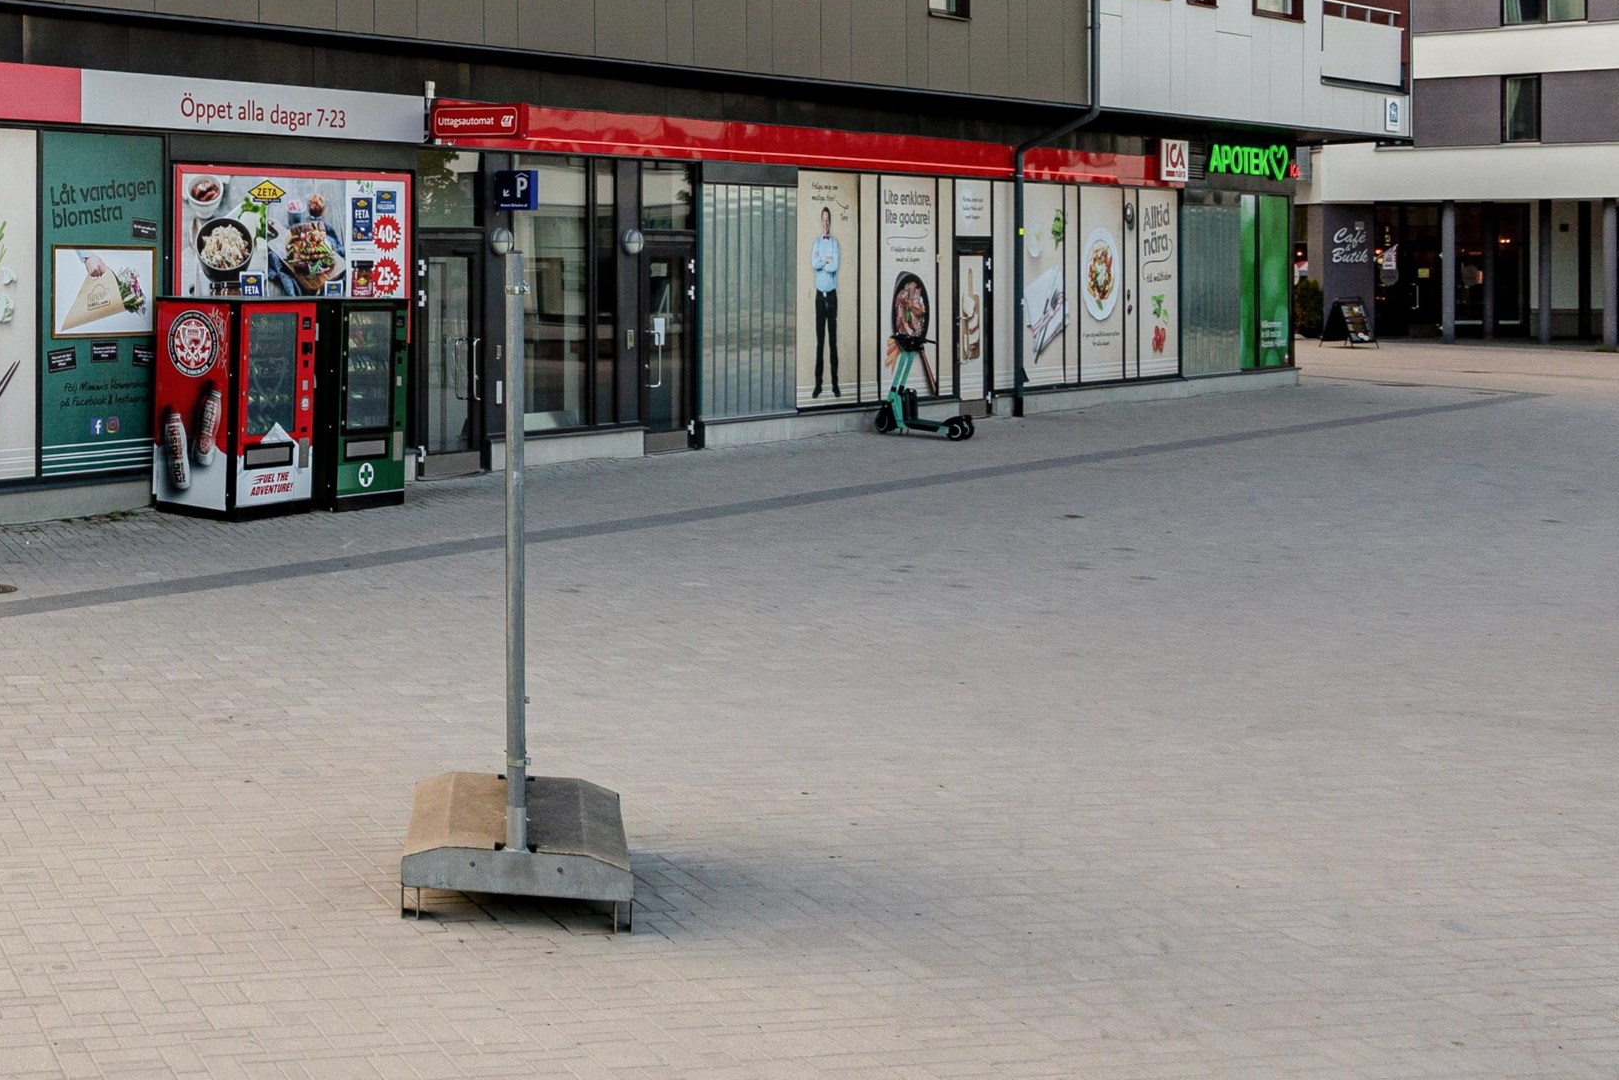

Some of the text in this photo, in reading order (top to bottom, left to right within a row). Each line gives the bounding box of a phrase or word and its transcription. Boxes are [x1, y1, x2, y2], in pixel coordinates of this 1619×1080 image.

[181, 92, 346, 132] Öppet alla dagar 7-23
[438, 116, 495, 129] Uttagsautomat
[1165, 143, 1186, 169] ICA
[1209, 144, 1270, 176] APOTEK
[50, 179, 157, 207] Låt vardagen
[257, 188, 278, 197] ZETA
[516, 177, 528, 198] P
[883, 190, 932, 208] Lite enklare,
[51, 204, 123, 230] blomstra
[354, 209, 370, 219] FETA
[885, 209, 931, 228] lite godare!
[1143, 202, 1170, 232] Alltid
[1143, 230, 1169, 257] nära
[1333, 227, 1367, 249] Café
[1331, 247, 1369, 263] Butik
[244, 285, 260, 295] FETA
[61, 398, 70, 408] på
[72, 395, 107, 406] Facebook
[201, 400, 214, 434] HUSKI
[168, 425, 181, 460] HUSKI
[252, 471, 289, 485] FUEL THE
[250, 482, 294, 497] ADVENTURE!
